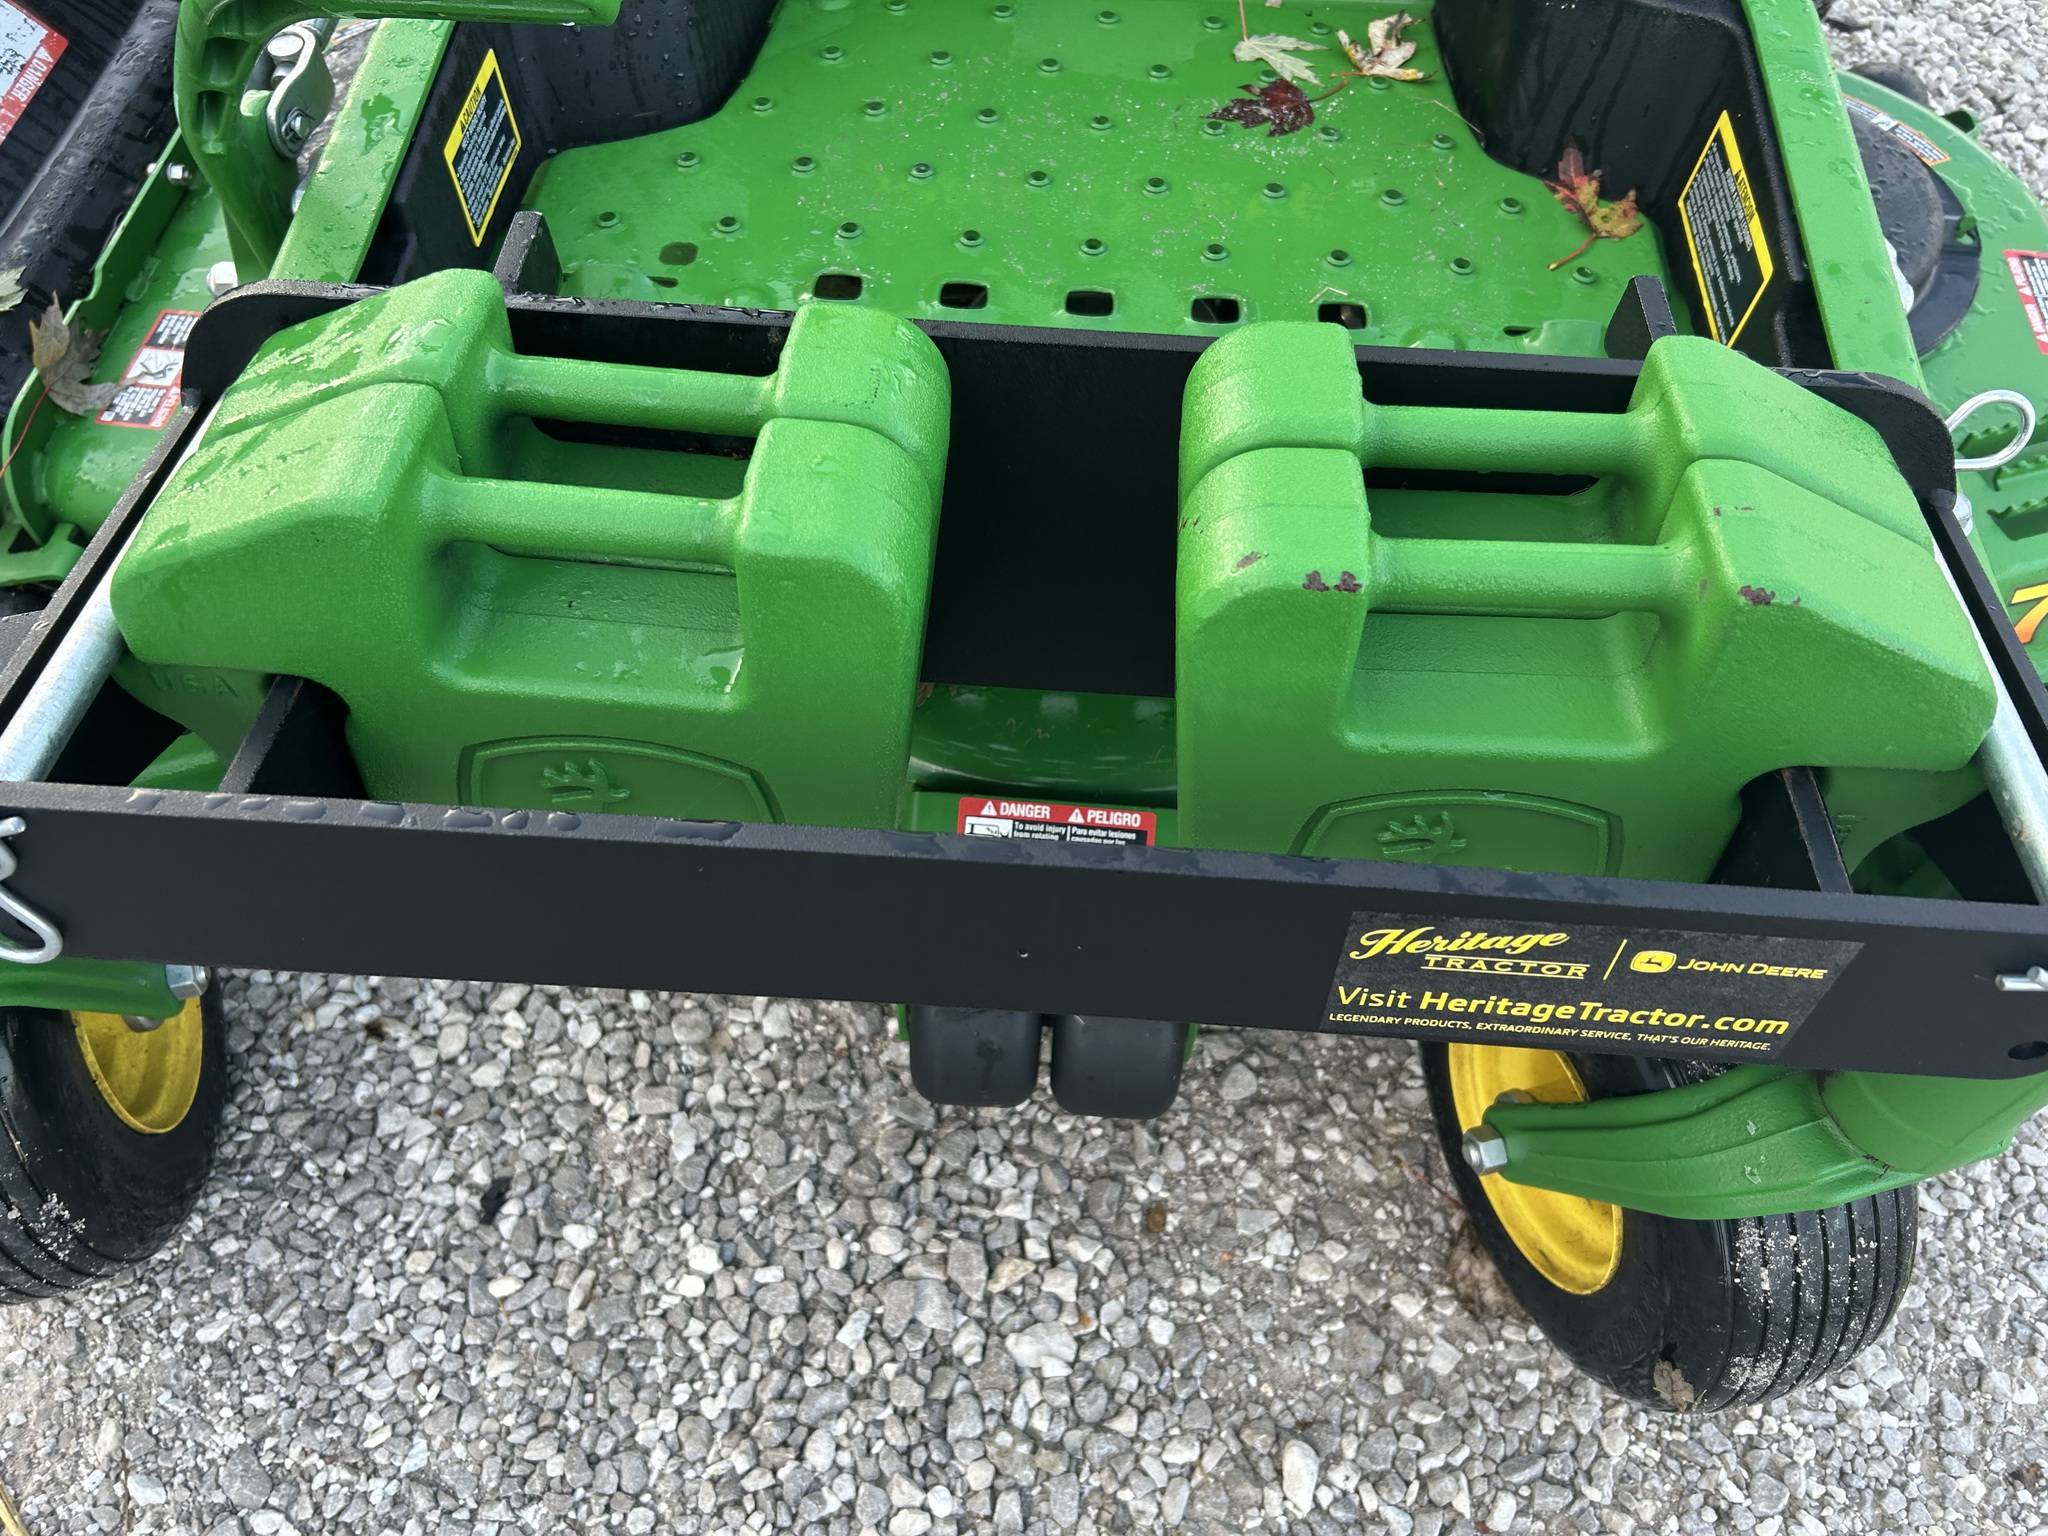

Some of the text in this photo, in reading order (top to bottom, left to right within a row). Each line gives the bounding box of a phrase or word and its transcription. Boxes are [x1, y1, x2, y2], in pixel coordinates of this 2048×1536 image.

[11, 59, 47, 102] DANGER
[463, 84, 481, 125] CAUTION
[1000, 802, 1050, 819] DANGER
[1087, 810, 1141, 827] PELIGRO
[1013, 830, 1059, 841] from rotating
[1014, 821, 1067, 835] To avoid injury
[1072, 826, 1136, 840] Para evitar lesiones
[1350, 926, 1570, 960] Heritage
[1424, 957, 1587, 977] TRACTOR
[1678, 958, 1828, 980] JOHN DEERE
[1338, 986, 1789, 1035] Visit HeritageTractor.com
[1329, 1013, 1771, 1051] LEGENDARY PRODUCTS, EXTRAORDINARY SERVICE, THAT'S OUR HERITAGE.
